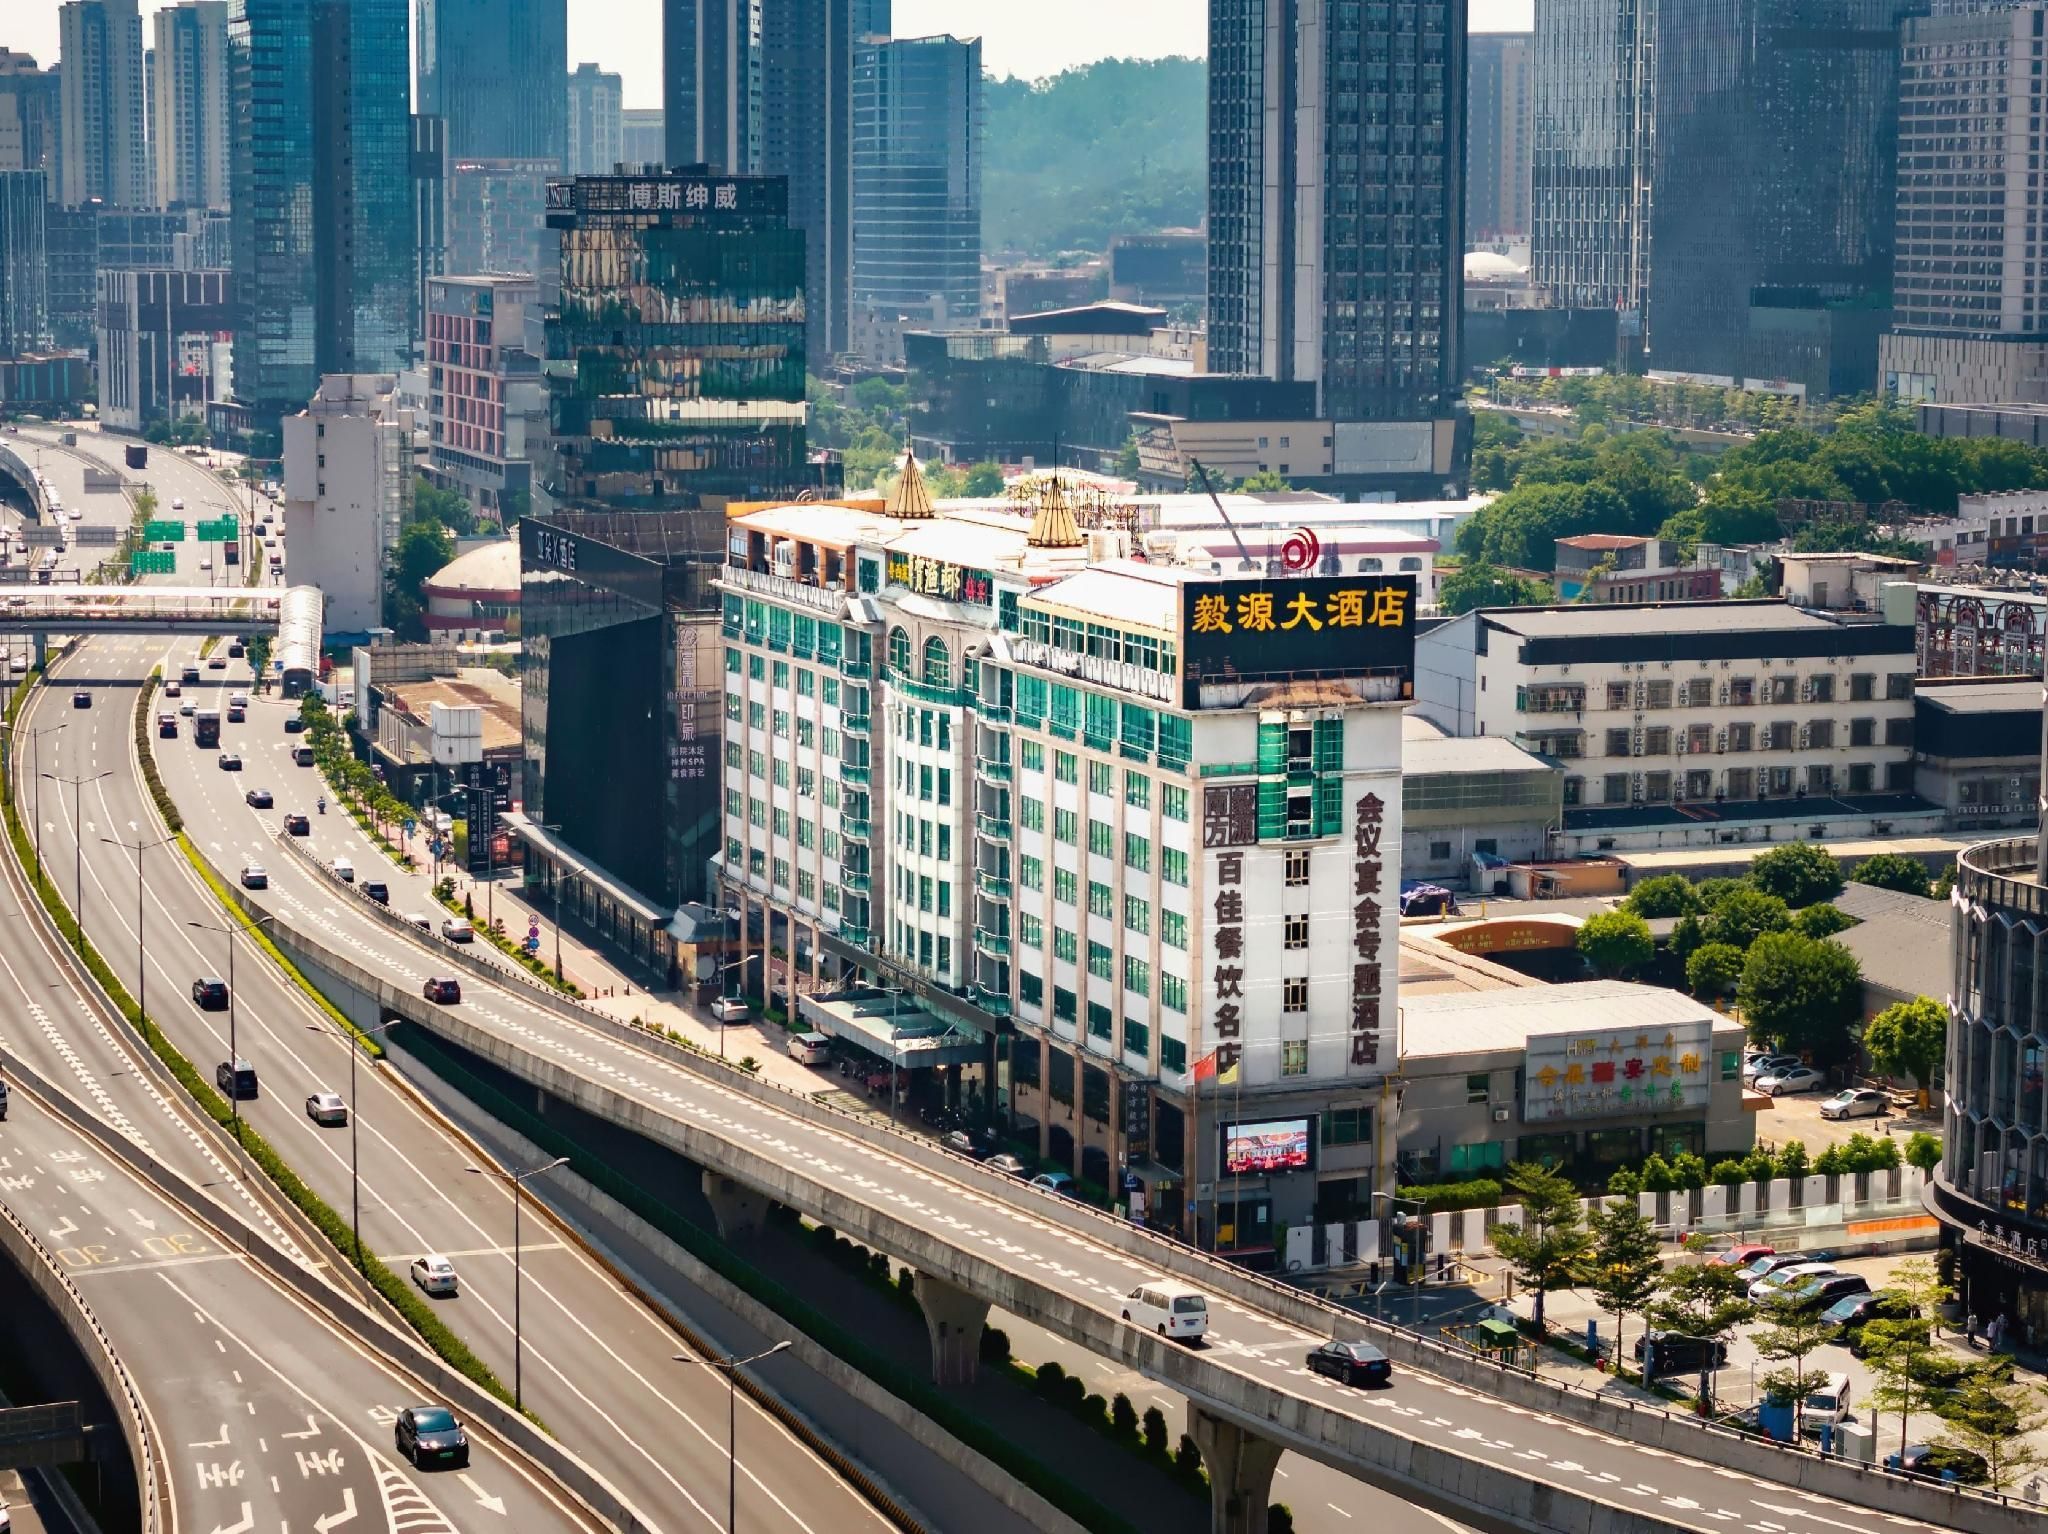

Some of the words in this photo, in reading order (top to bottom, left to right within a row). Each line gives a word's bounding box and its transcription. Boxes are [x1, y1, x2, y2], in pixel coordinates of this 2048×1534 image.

[628, 182, 737, 210] 博斯绅威
[188, 1423, 246, 1490] 广州
[281, 1414, 345, 1479] 广州
